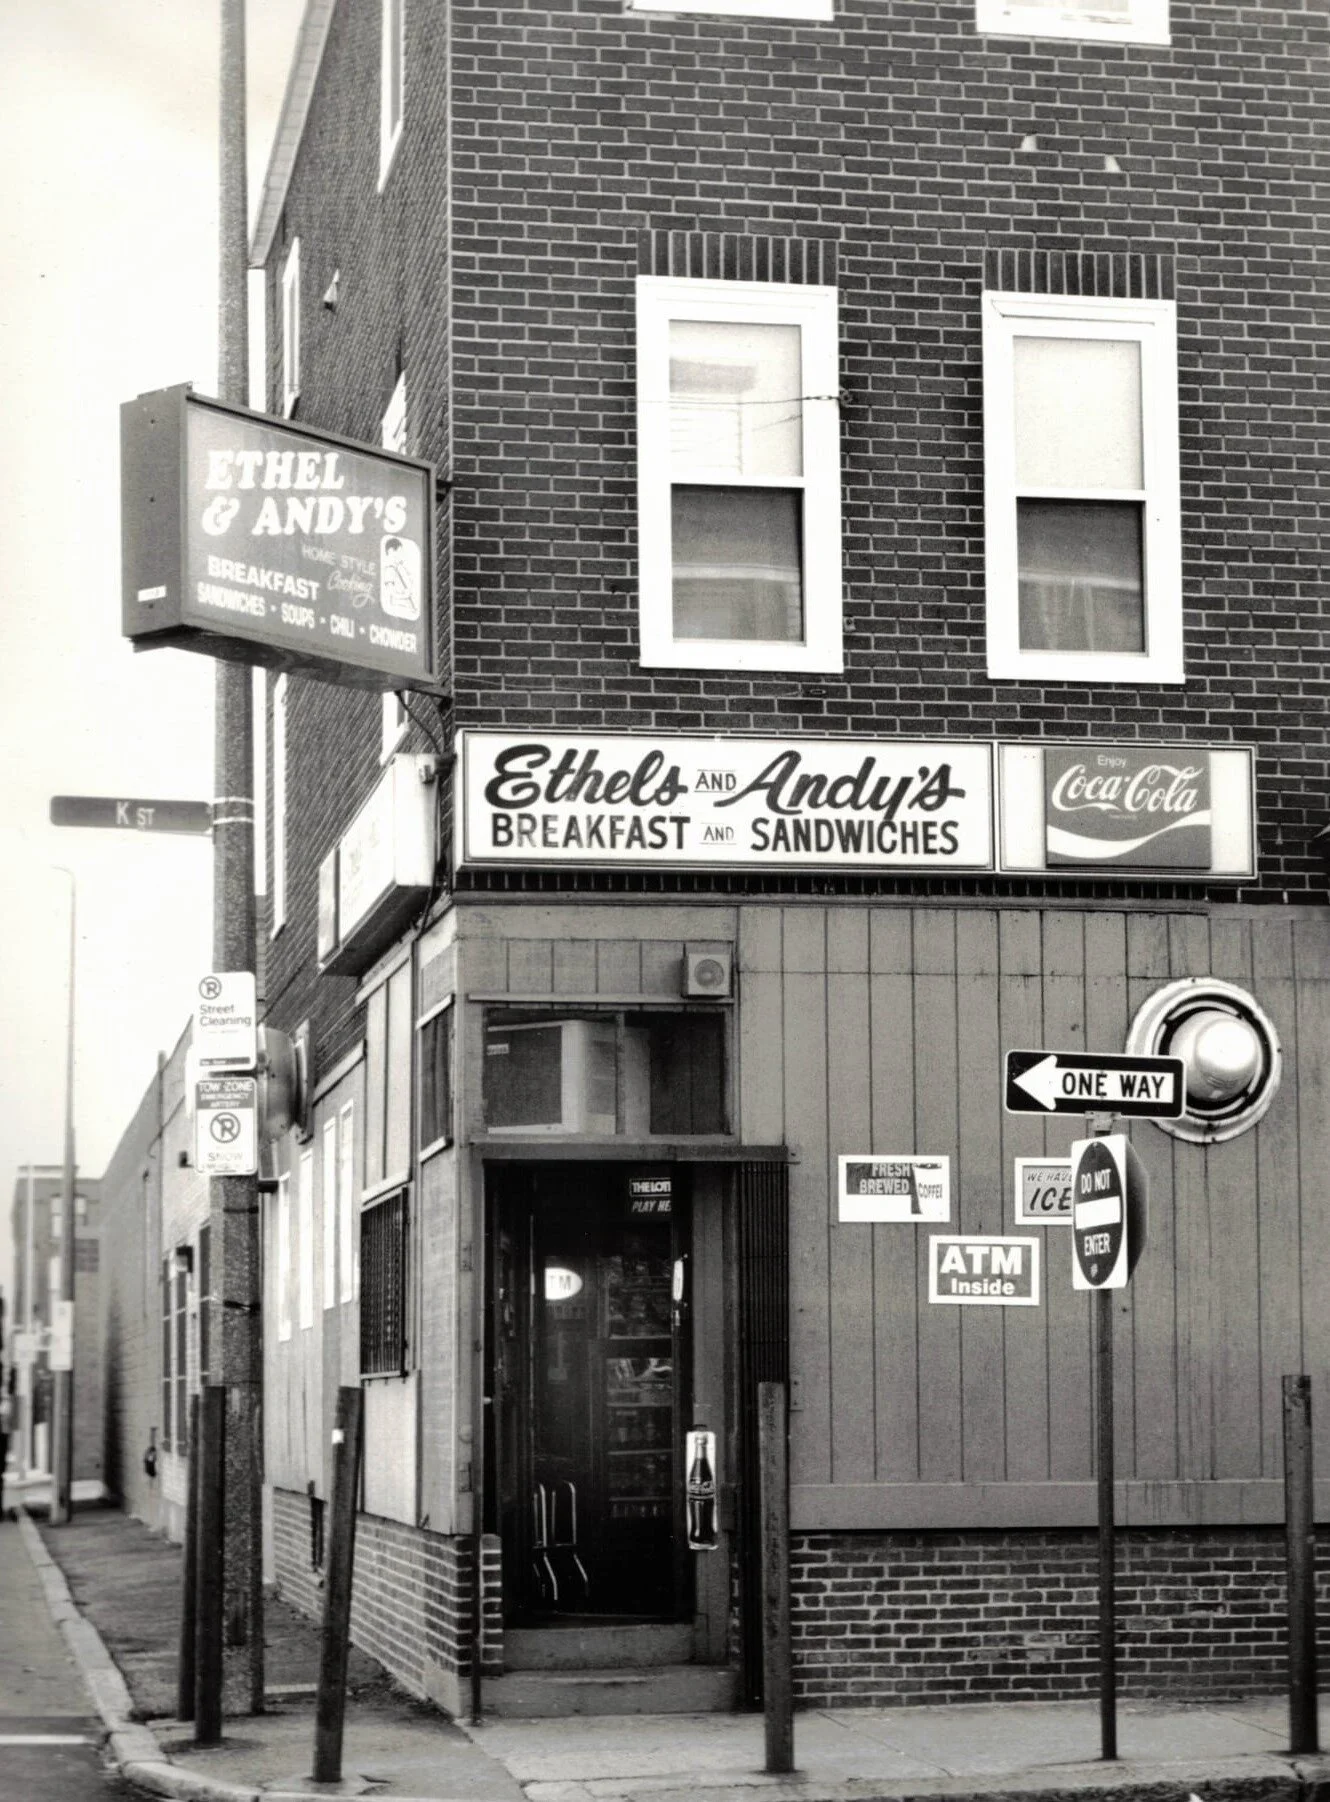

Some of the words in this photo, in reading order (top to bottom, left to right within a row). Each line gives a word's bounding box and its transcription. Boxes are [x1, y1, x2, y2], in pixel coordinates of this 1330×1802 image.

[204, 450, 345, 491] ETHEL
[202, 496, 240, 536] &
[251, 496, 407, 536] ANDY'S
[301, 544, 335, 566] HOME
[341, 554, 377, 577] STYLE
[208, 555, 319, 601] BREAKFAST
[197, 581, 266, 617] SANDWICHES
[280, 602, 315, 629] SOUPS
[330, 614, 355, 639] CHILI
[369, 623, 418, 653] CHOWDER
[1097, 754, 1127, 769] Enjoy
[485, 743, 689, 810] Ethels
[697, 769, 736, 791] AND
[714, 749, 966, 820] Andy's
[116, 800, 129, 825] K
[136, 806, 155, 826] ST
[491, 814, 691, 851] BREAKFAST
[703, 825, 735, 843] AND
[751, 817, 960, 856] SANDWICHES
[199, 1003, 235, 1016] Street
[199, 1015, 252, 1028] Cleaning
[199, 1081, 222, 1093] TOW
[223, 1080, 253, 1092] ZONE
[1061, 1071, 1108, 1097] ONE
[1120, 1073, 1165, 1099] WAY
[871, 1162, 911, 1178] FRESH
[1027, 1171, 1043, 1182] WE
[1081, 1173, 1093, 1195] DO
[1094, 1168, 1111, 1192] NOT
[632, 1182, 650, 1194] THE
[859, 1178, 910, 1195] BREWED
[1029, 1186, 1072, 1211] ICE
[631, 1199, 657, 1213] PLAY
[1083, 1232, 1111, 1257] ENTER
[940, 1245, 1022, 1275] ATM
[951, 1278, 1015, 1296] Inside
